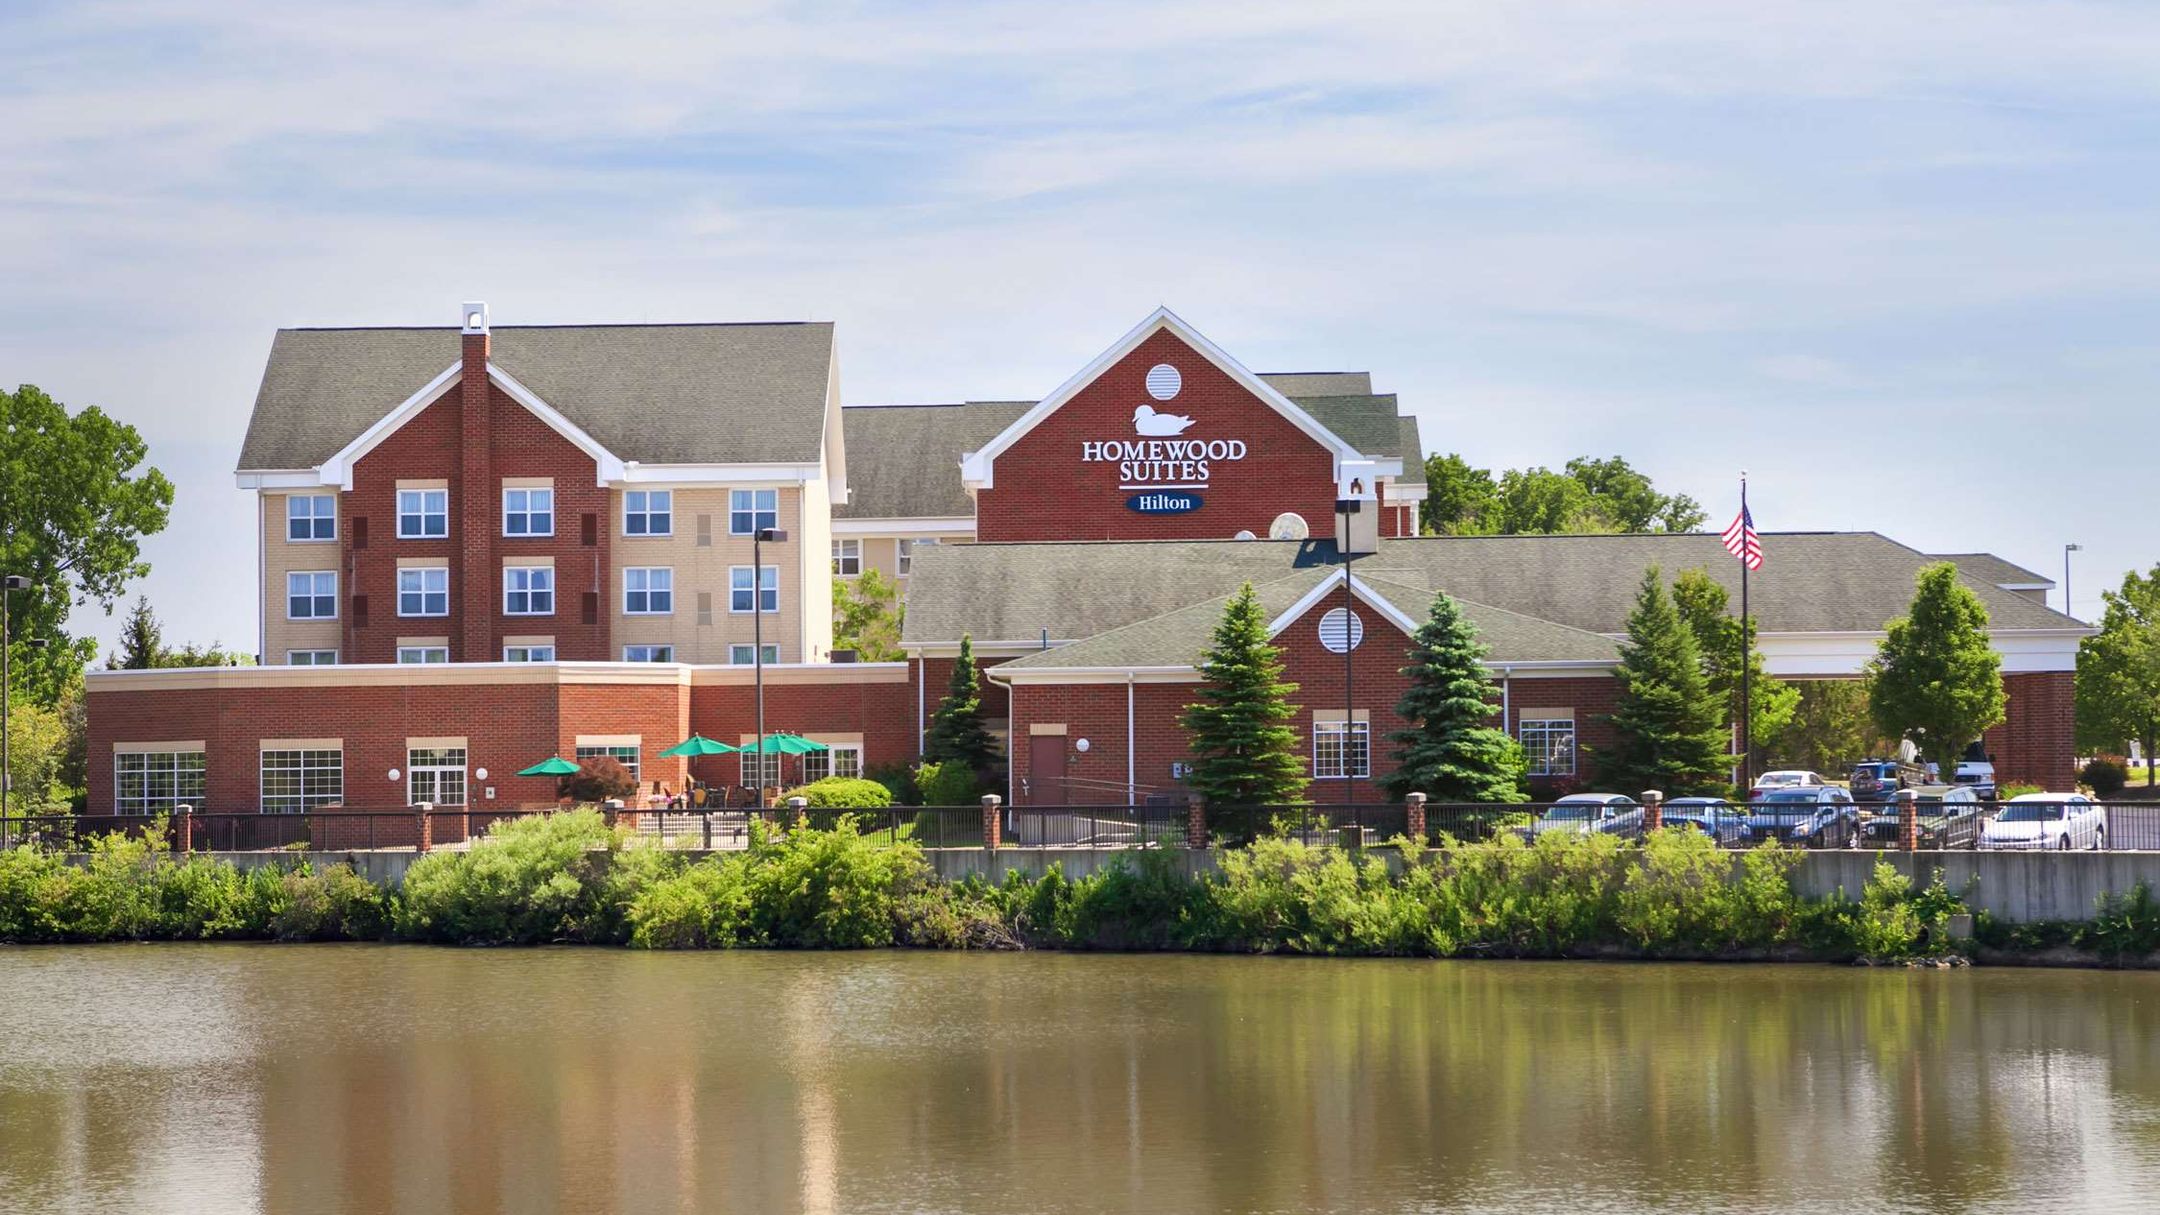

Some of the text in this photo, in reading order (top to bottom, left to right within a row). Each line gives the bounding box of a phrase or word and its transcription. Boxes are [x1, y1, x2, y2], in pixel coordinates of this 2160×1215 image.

[1082, 440, 1247, 461] HOMEWOOD
[1120, 460, 1209, 481] SUITES
[1139, 494, 1191, 510] Hilton
